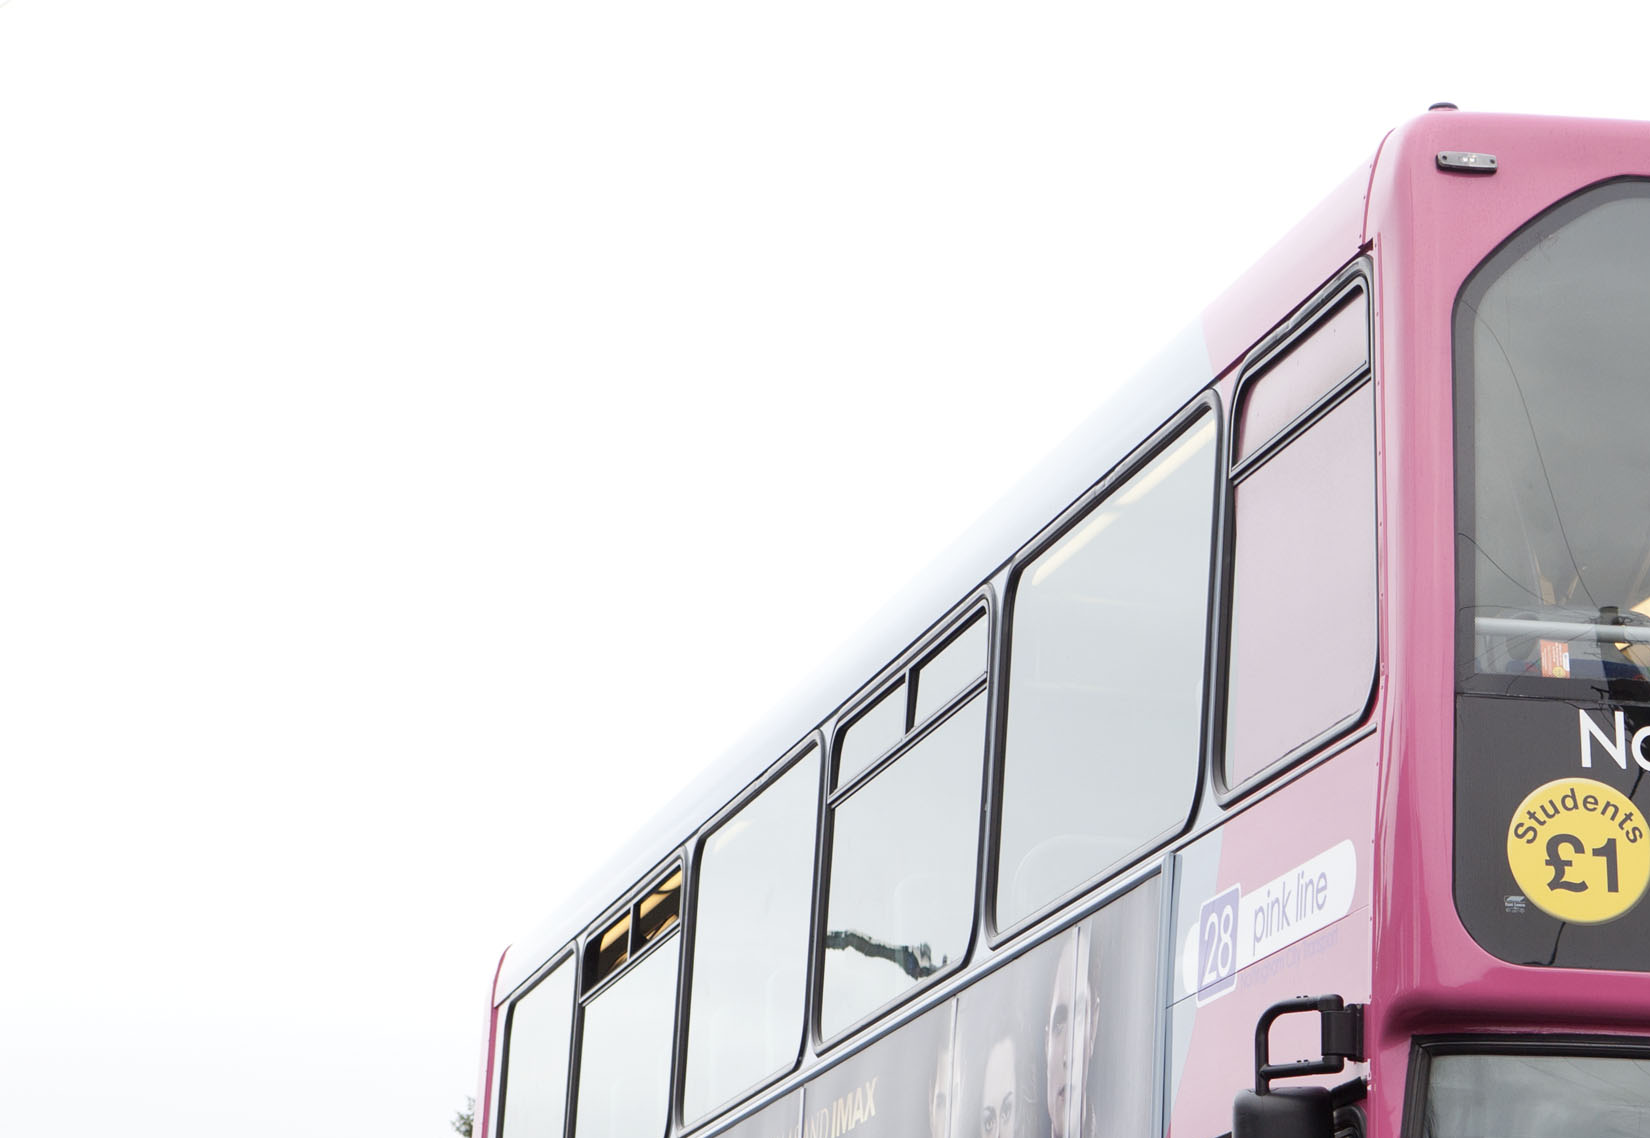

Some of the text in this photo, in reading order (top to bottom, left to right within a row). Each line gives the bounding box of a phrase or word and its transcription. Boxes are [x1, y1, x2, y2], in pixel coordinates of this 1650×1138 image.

[1513, 787, 1644, 844] Students
[1544, 833, 1620, 893] £1
[1202, 870, 1328, 986] 28 pink line
